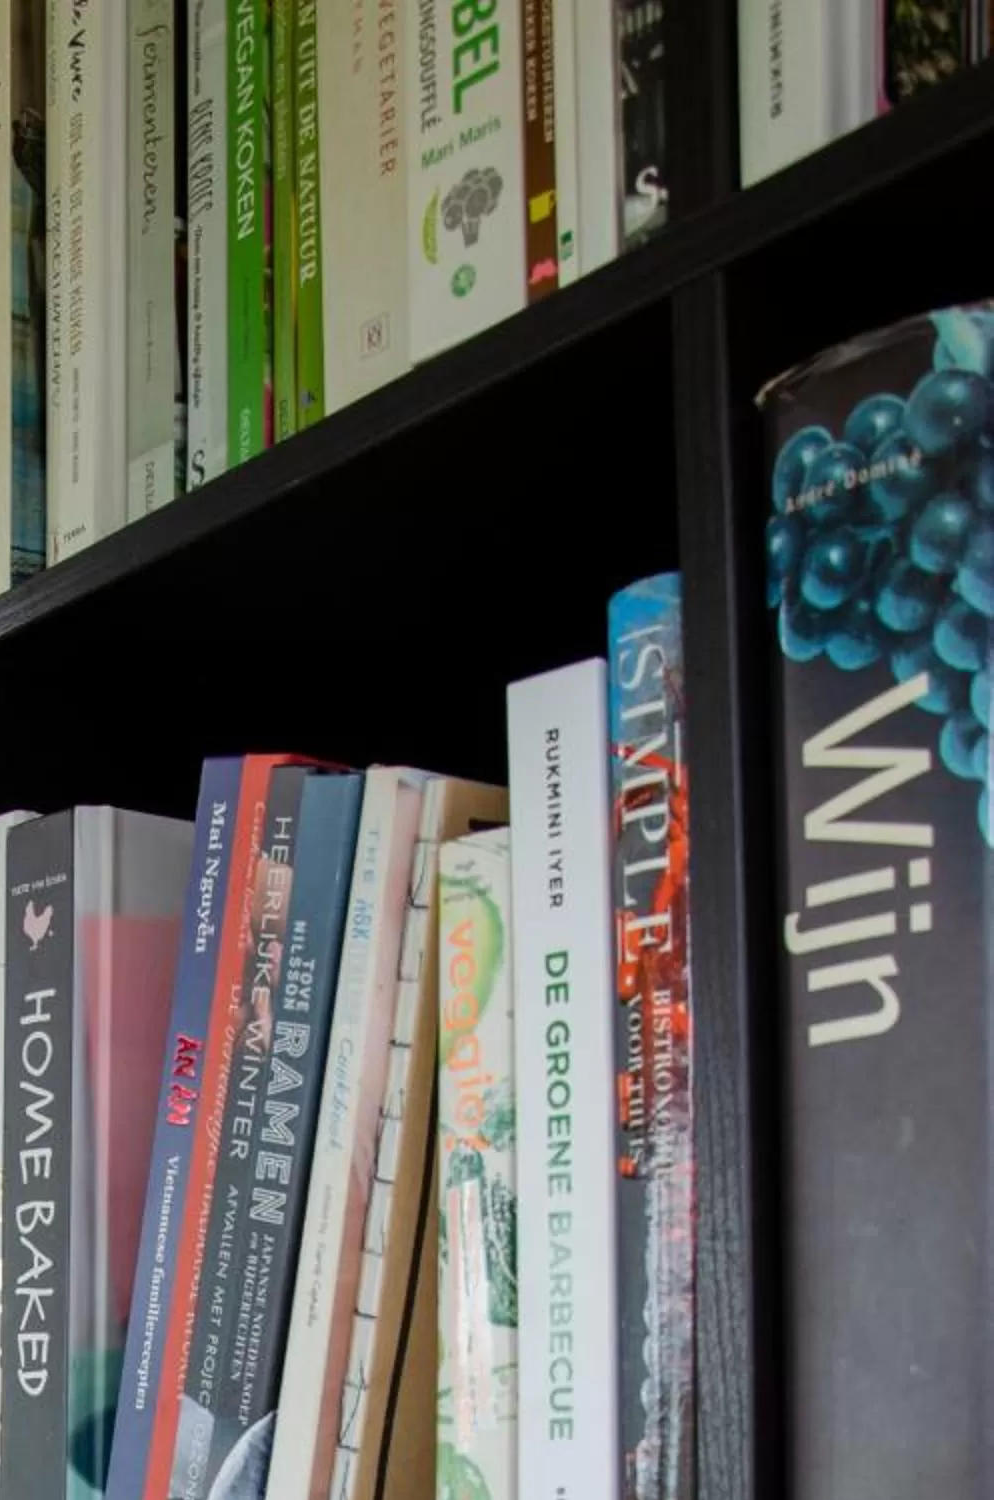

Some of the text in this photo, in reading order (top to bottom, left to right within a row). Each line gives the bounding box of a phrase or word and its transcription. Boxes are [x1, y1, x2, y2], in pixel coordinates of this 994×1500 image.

[236, 0, 255, 240] VEGAN KOKEN
[297, 37, 318, 288] UIT DE NATUUR
[421, 116, 502, 170] Mari Maris
[207, 800, 227, 851] Mai
[545, 729, 564, 908] RUKMINI IYER
[784, 671, 936, 1047] Wijn
[229, 815, 294, 1161] HEERLIJKE WINTER
[282, 920, 307, 1011] NILSSON
[295, 958, 315, 1012] TOVE
[626, 993, 644, 1073] VOOR
[14, 987, 55, 1397] HOME BAKED
[249, 1020, 311, 1226] RAMEN
[545, 951, 574, 1441] DE GROENE BARBECUE
[134, 1155, 181, 1411] Vietnamese familierecepten
[209, 1286, 226, 1328] MET
[213, 1184, 242, 1281] AFVALLEN
[228, 1253, 258, 1382] BIJGERECHTEN
[239, 1235, 276, 1425] JAPANSE NOEDELSOEP
